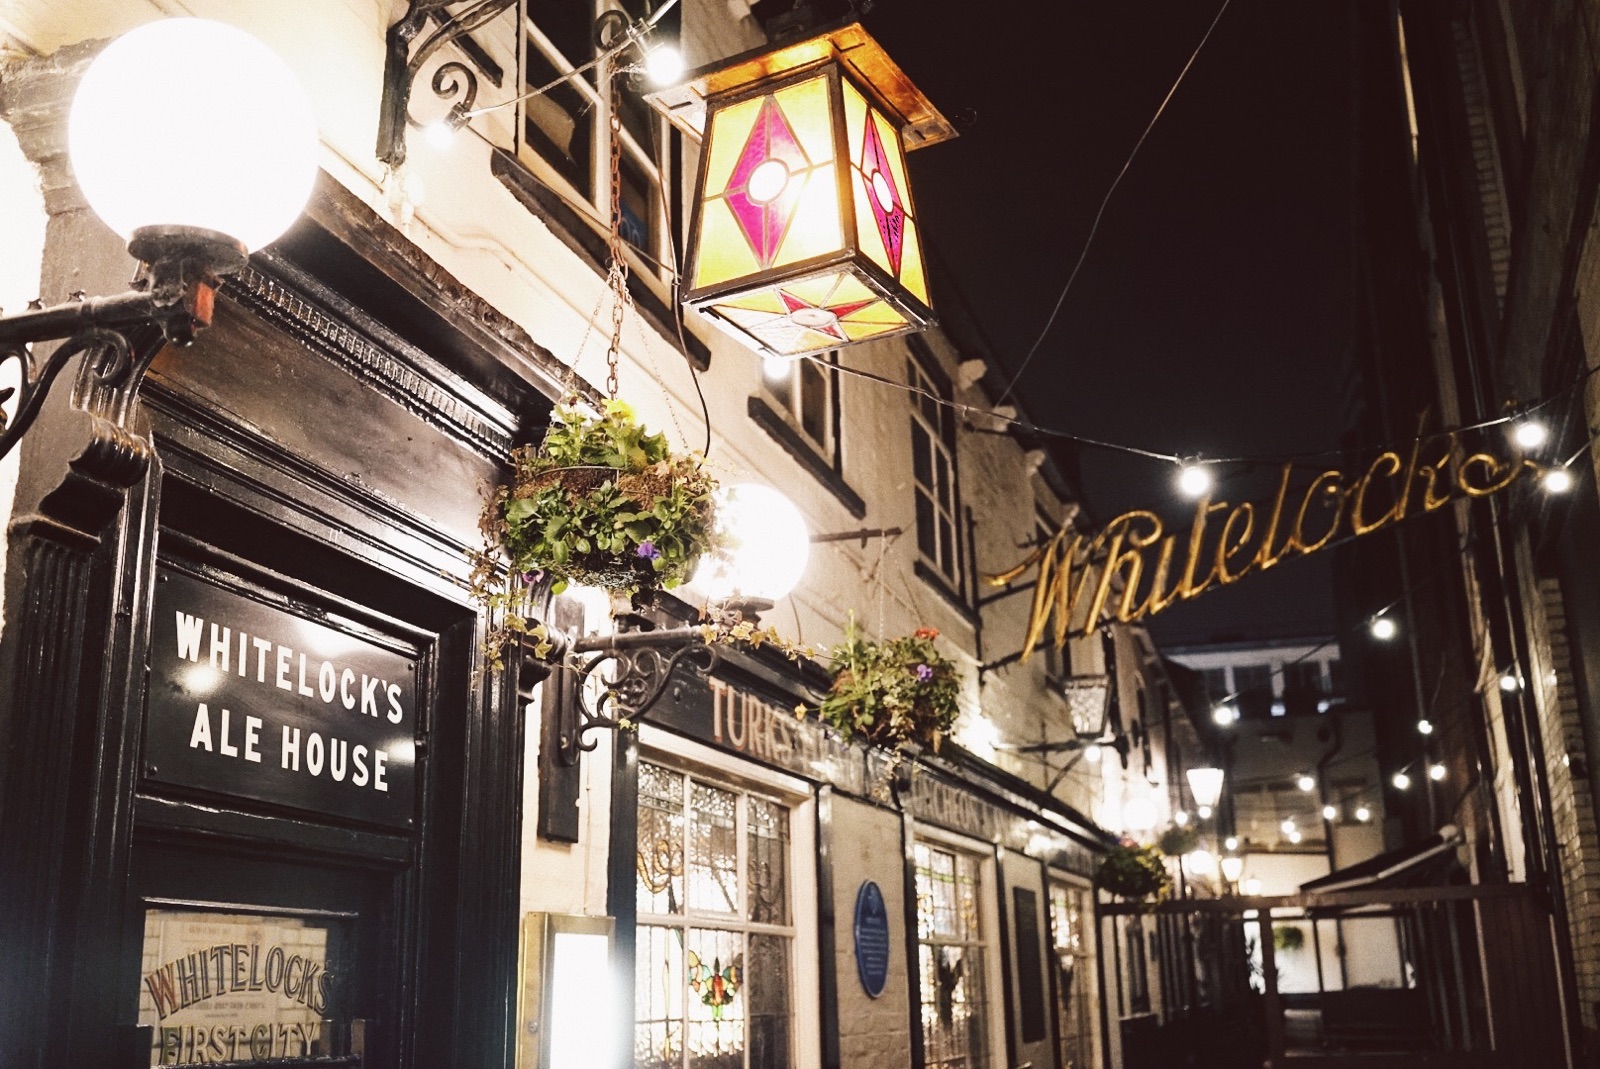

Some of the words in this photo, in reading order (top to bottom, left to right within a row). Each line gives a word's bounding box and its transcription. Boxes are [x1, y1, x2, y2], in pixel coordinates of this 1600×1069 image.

[175, 611, 402, 724] WHITELOCK'S
[189, 703, 262, 764] ALE
[281, 725, 388, 792] HOUSE
[144, 943, 333, 1020] WHITELOCKS
[159, 1023, 246, 1065] FIRST
[251, 1022, 318, 1061] CITY
